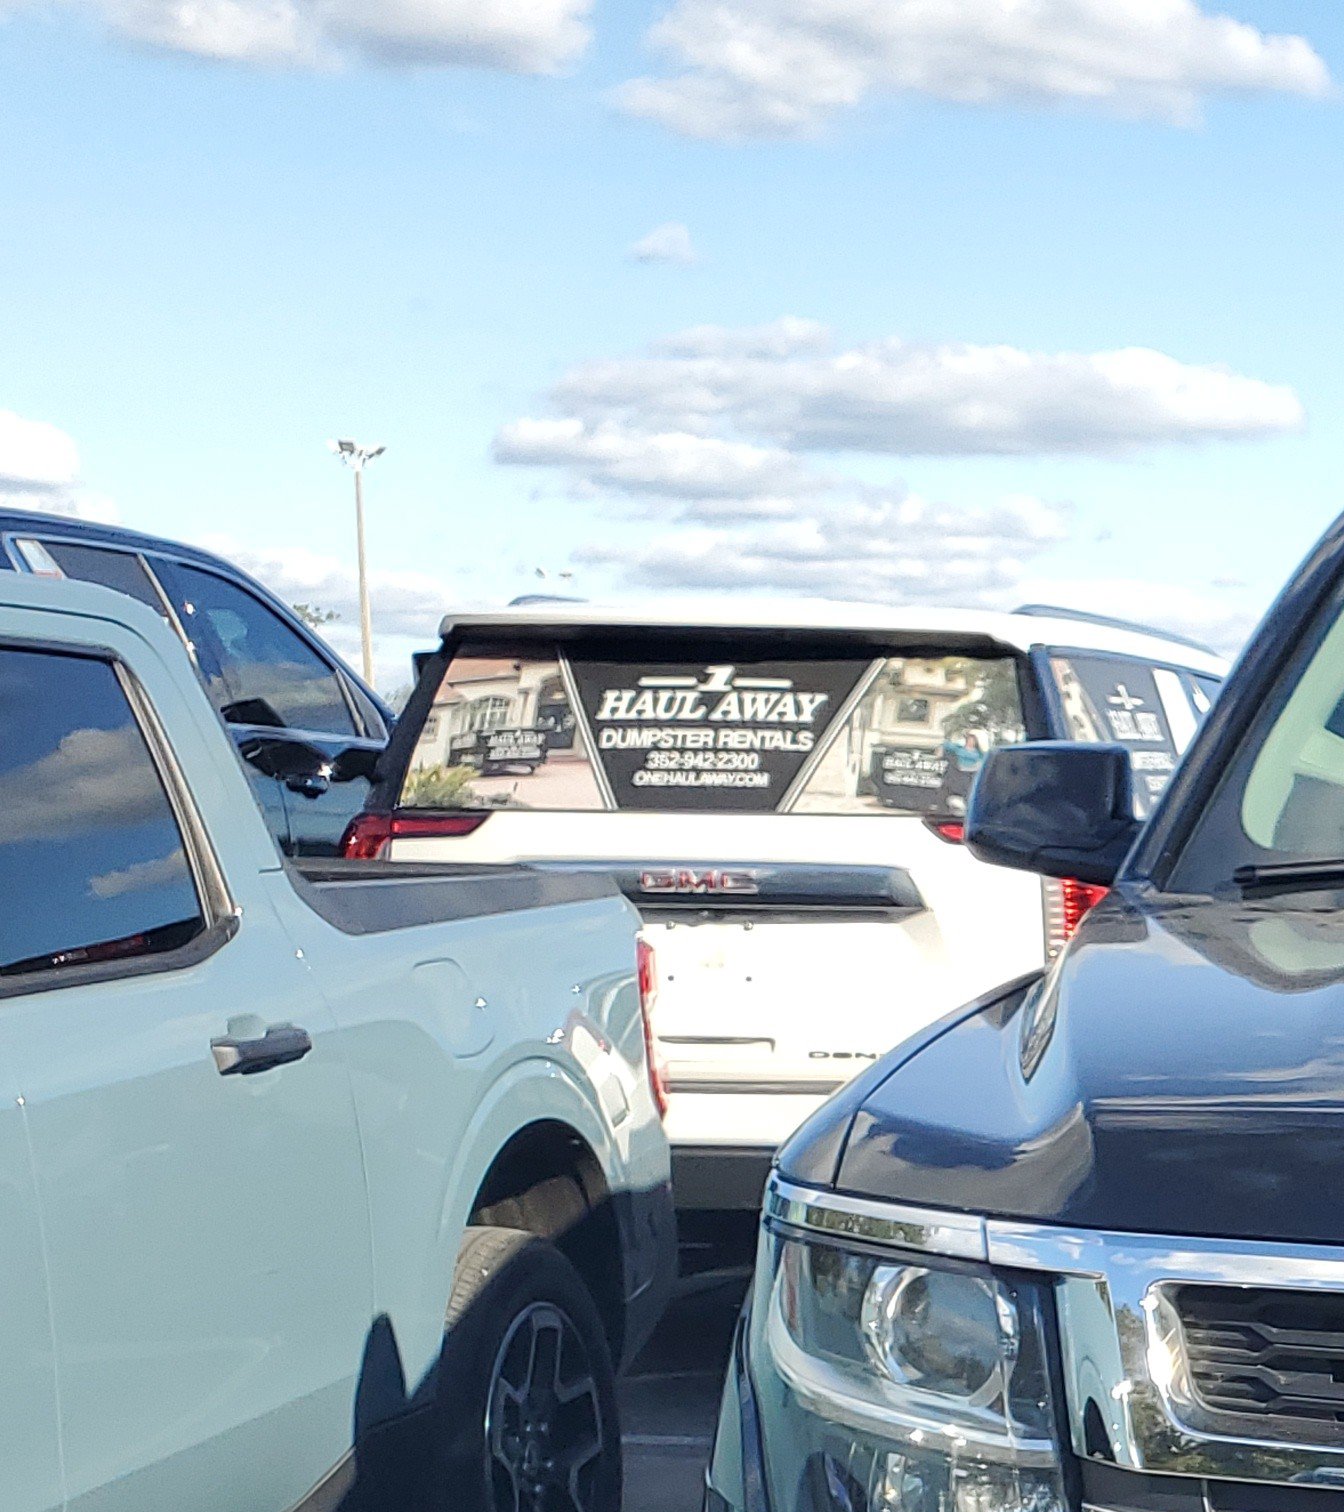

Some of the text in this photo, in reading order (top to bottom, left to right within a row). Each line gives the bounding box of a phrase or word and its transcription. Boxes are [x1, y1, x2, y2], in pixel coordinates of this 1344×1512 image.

[595, 689, 829, 722] HAUL AWAY
[600, 727, 815, 751] DUMPSTER RENTALS
[645, 751, 760, 770] 352-942-2300
[641, 868, 759, 894] GMC
